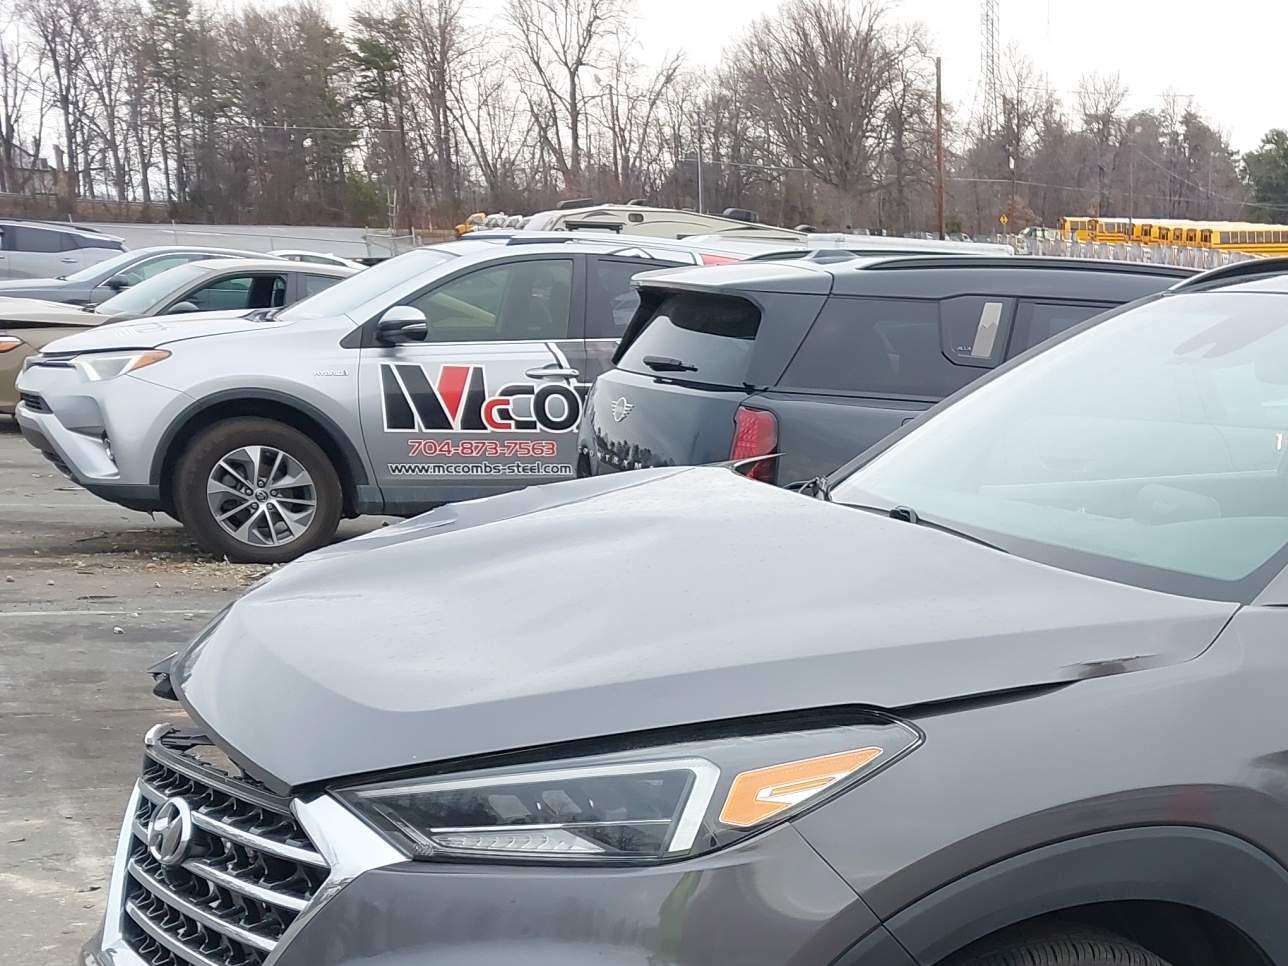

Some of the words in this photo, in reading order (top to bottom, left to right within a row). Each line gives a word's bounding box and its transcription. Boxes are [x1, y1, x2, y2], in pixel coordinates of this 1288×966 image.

[378, 362, 591, 433] McCO
[408, 440, 556, 457] 704-873-7563
[388, 462, 572, 475] www.mccombs-steel.com
